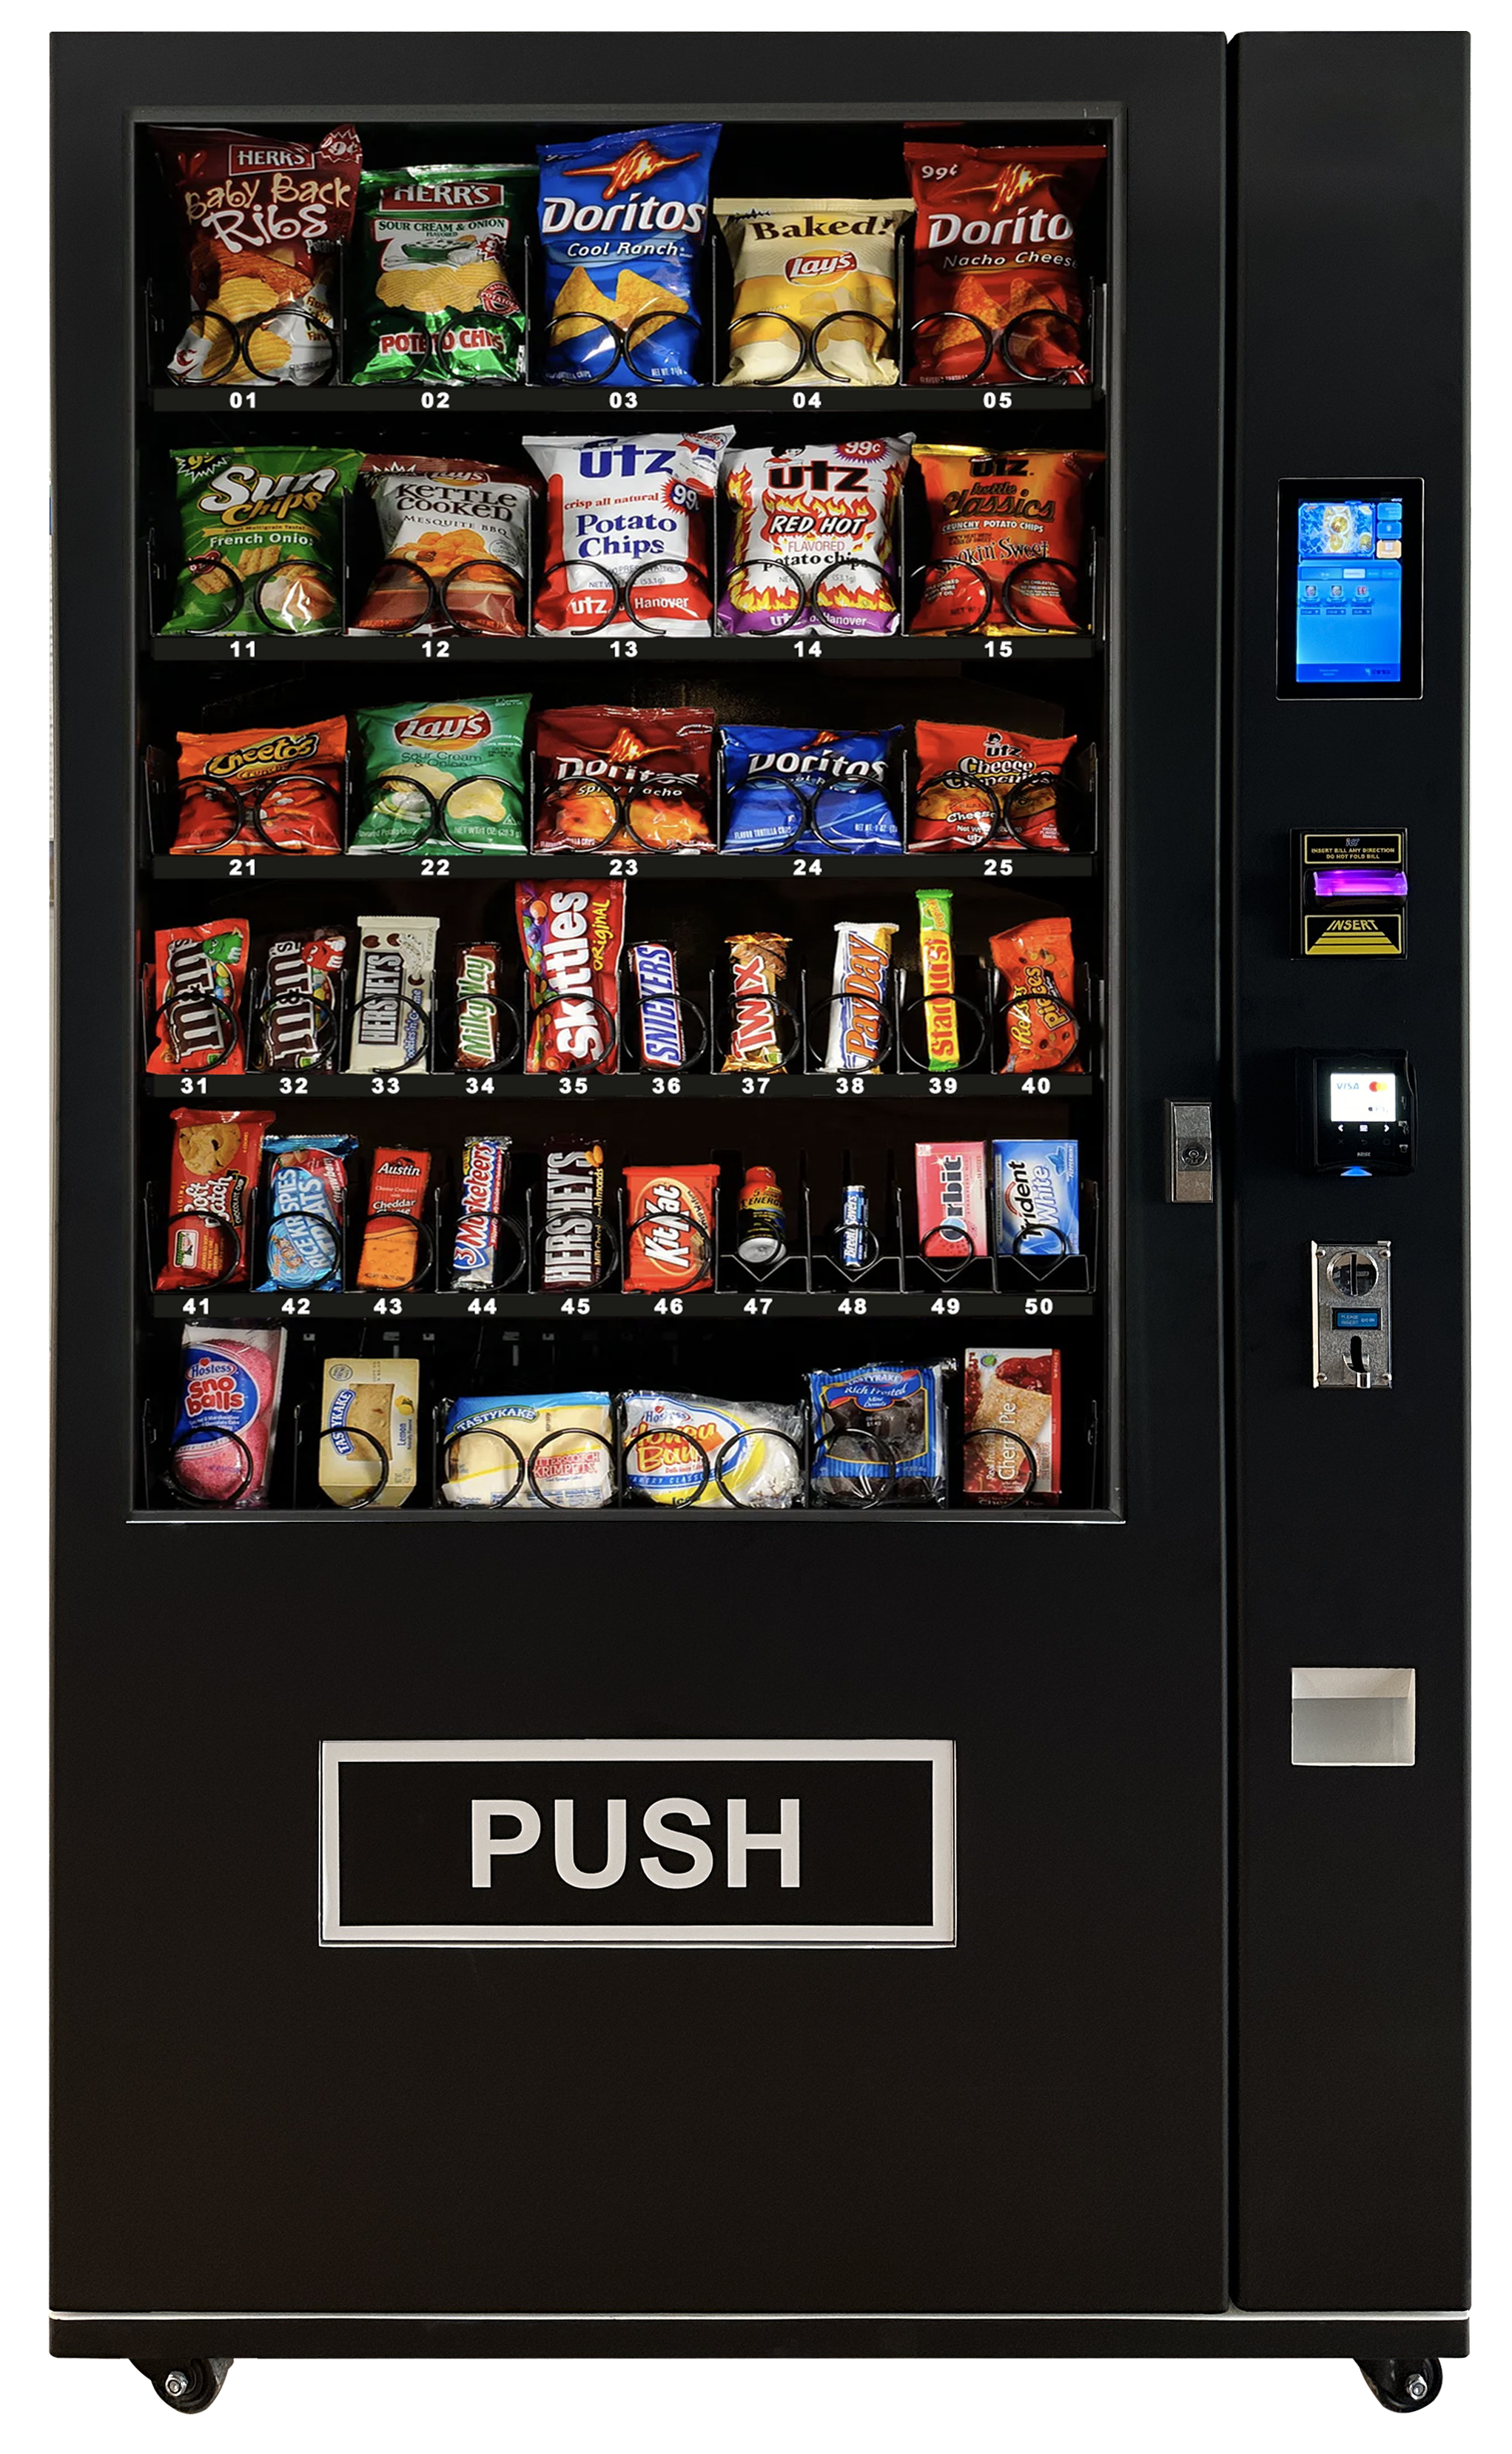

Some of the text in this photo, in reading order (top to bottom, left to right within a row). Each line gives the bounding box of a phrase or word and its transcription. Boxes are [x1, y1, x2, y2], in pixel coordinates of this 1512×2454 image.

[921, 164, 958, 180] 99¢
[185, 172, 352, 224] Baby Back
[394, 184, 491, 206] HERR'S
[542, 192, 706, 234] Doritos
[201, 204, 328, 254] Ribs
[378, 218, 505, 232] SOUR CREAM & ONION
[749, 215, 893, 241] Baked!
[567, 242, 609, 258] Cool
[943, 254, 1006, 269] Nacho
[229, 391, 257, 409] 01
[421, 391, 450, 409] 02
[609, 391, 638, 409] 03
[793, 391, 821, 409] 04
[984, 391, 1012, 409] 05
[768, 460, 869, 493] utz
[198, 465, 337, 512] Sun
[221, 491, 323, 525] Chips
[565, 492, 659, 511] crisp all natural
[403, 515, 511, 540] MESQUITE BBQ
[576, 513, 677, 537] Potato
[770, 515, 865, 535] RED HOT
[941, 520, 1044, 534] CRUNCHY POTATO CHIPS
[209, 534, 263, 548] French
[578, 535, 665, 559] Chips
[788, 540, 846, 553] FLAVORED
[998, 538, 1049, 559] Sweet
[634, 596, 689, 609] Hanover
[230, 641, 255, 658] 11
[422, 641, 450, 658] 12
[610, 641, 638, 658] 13
[793, 641, 822, 658] 14
[984, 641, 1012, 658] 15
[207, 736, 316, 776] Cheetos
[401, 752, 431, 763] Sour
[436, 751, 482, 762] Cream
[414, 759, 424, 767] &
[748, 750, 888, 782] Doritos
[960, 756, 1035, 775] Cheese
[947, 811, 996, 823] Cheese
[229, 858, 255, 875] 21
[421, 858, 450, 875] 22
[610, 858, 638, 875] 23
[793, 858, 822, 875] 24
[984, 858, 1012, 875] 25
[1326, 920, 1379, 930] INSERT
[360, 954, 403, 1043] HERSHEY'S
[457, 955, 497, 1059] Milky Way
[731, 956, 778, 1060] TWIX
[181, 1078, 206, 1095] 31
[280, 1078, 308, 1095] 32
[372, 1078, 400, 1095] 33
[466, 1078, 494, 1095] 34
[560, 1078, 588, 1095] 35
[652, 1078, 681, 1095] 36
[742, 1078, 770, 1095] 37
[836, 1078, 864, 1095] 38
[929, 1078, 958, 1095] 39
[1021, 1078, 1050, 1095] 40
[377, 1163, 421, 1177] Austin
[753, 1188, 761, 1197] 5
[1033, 1165, 1060, 1226] White
[373, 1199, 416, 1210] Cheddar
[545, 1152, 594, 1283] HERSHEY'S
[293, 1235, 329, 1269] RICE
[454, 1248, 476, 1265] 3
[183, 1298, 209, 1315] 41
[281, 1298, 310, 1315] 42
[374, 1298, 402, 1315] 43
[468, 1298, 497, 1315] 44
[561, 1298, 590, 1315] 45
[654, 1298, 683, 1315] 46
[744, 1298, 773, 1315] 47
[838, 1298, 867, 1315] 48
[931, 1298, 960, 1315] 49
[1025, 1298, 1053, 1315] 50
[191, 1359, 232, 1376] Hostess
[189, 1378, 235, 1399] sno
[844, 1382, 908, 1396] Rich Frosted
[186, 1394, 244, 1416] balls
[999, 1401, 1017, 1424] Pie
[332, 1391, 354, 1455] TASYKAKE
[456, 1408, 537, 1432] TASTYKAKE
[397, 1422, 407, 1447] Lemon
[471, 1798, 799, 1889] PUSH
